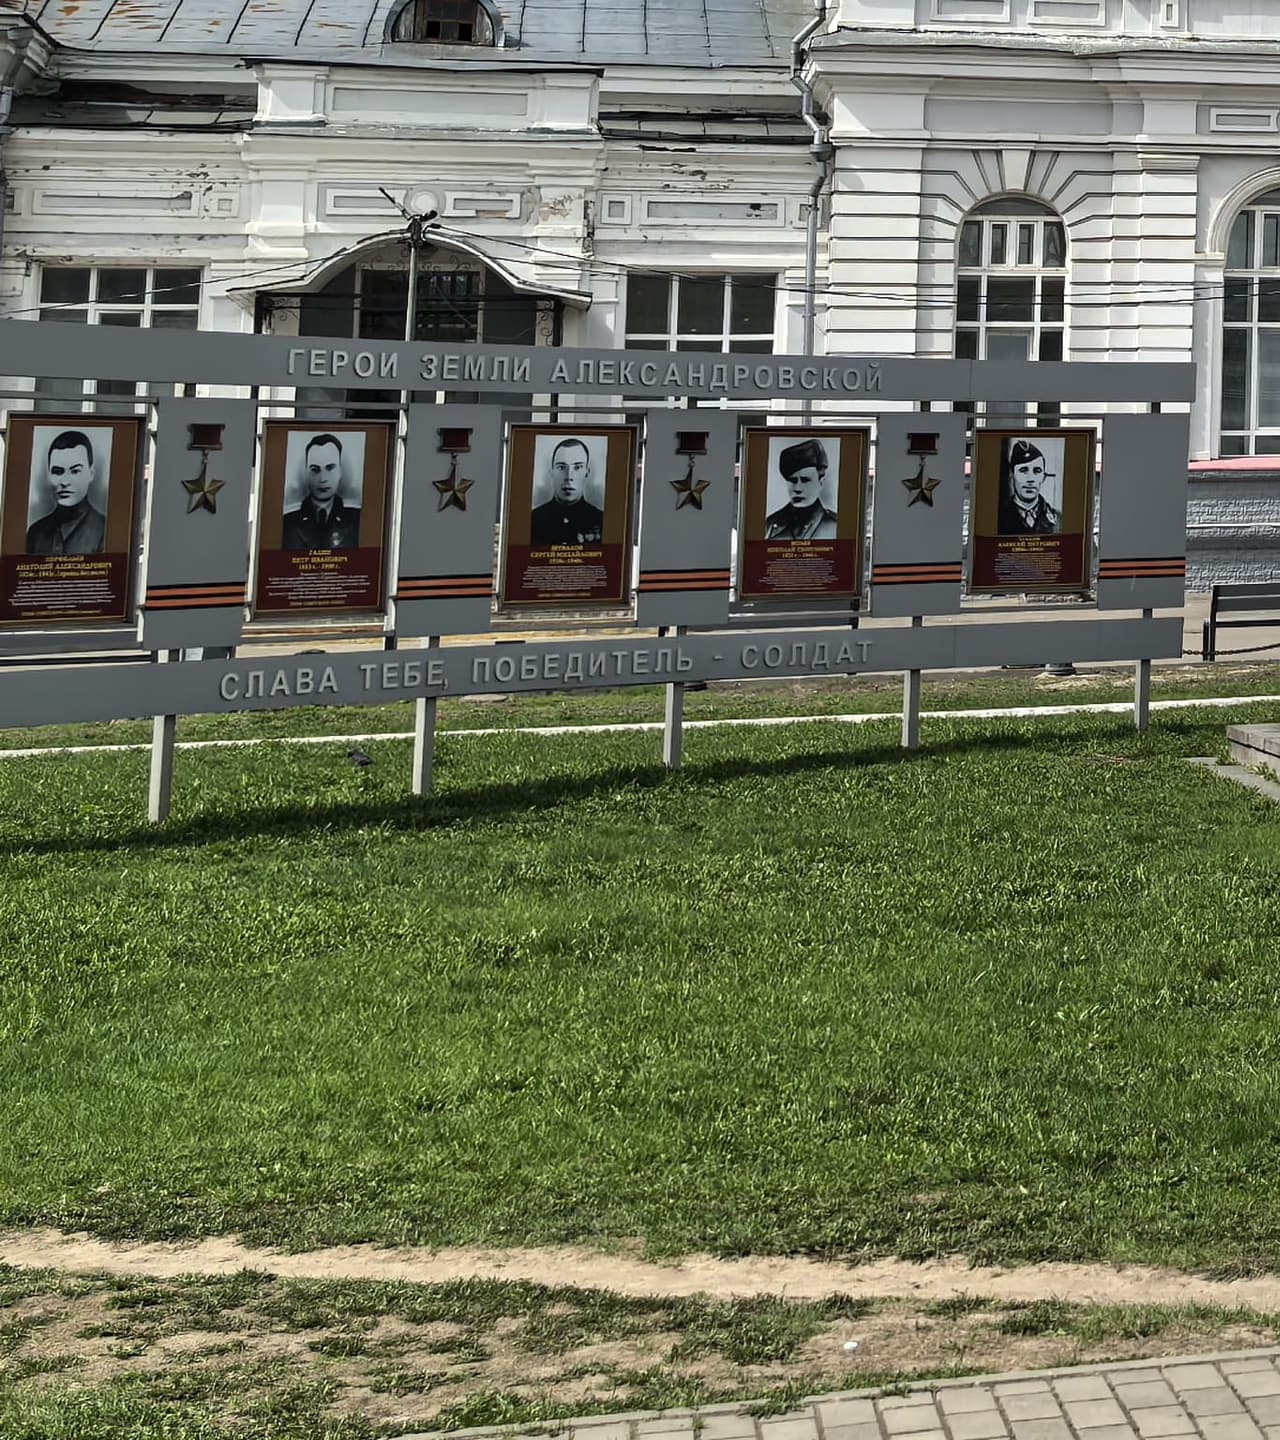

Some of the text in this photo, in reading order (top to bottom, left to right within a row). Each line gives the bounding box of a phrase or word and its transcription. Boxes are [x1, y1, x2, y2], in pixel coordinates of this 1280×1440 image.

[287, 348, 884, 393] ГЕРОИ ЗЕМЛИ АЛЕКСАНДРОВСКОЙ
[220, 666, 339, 701] СЛАВА
[360, 659, 449, 692] ТЕБЕ,
[472, 646, 694, 685] ПОБЕДИТЕЛЬ
[741, 639, 874, 671] СОЛДАТ
